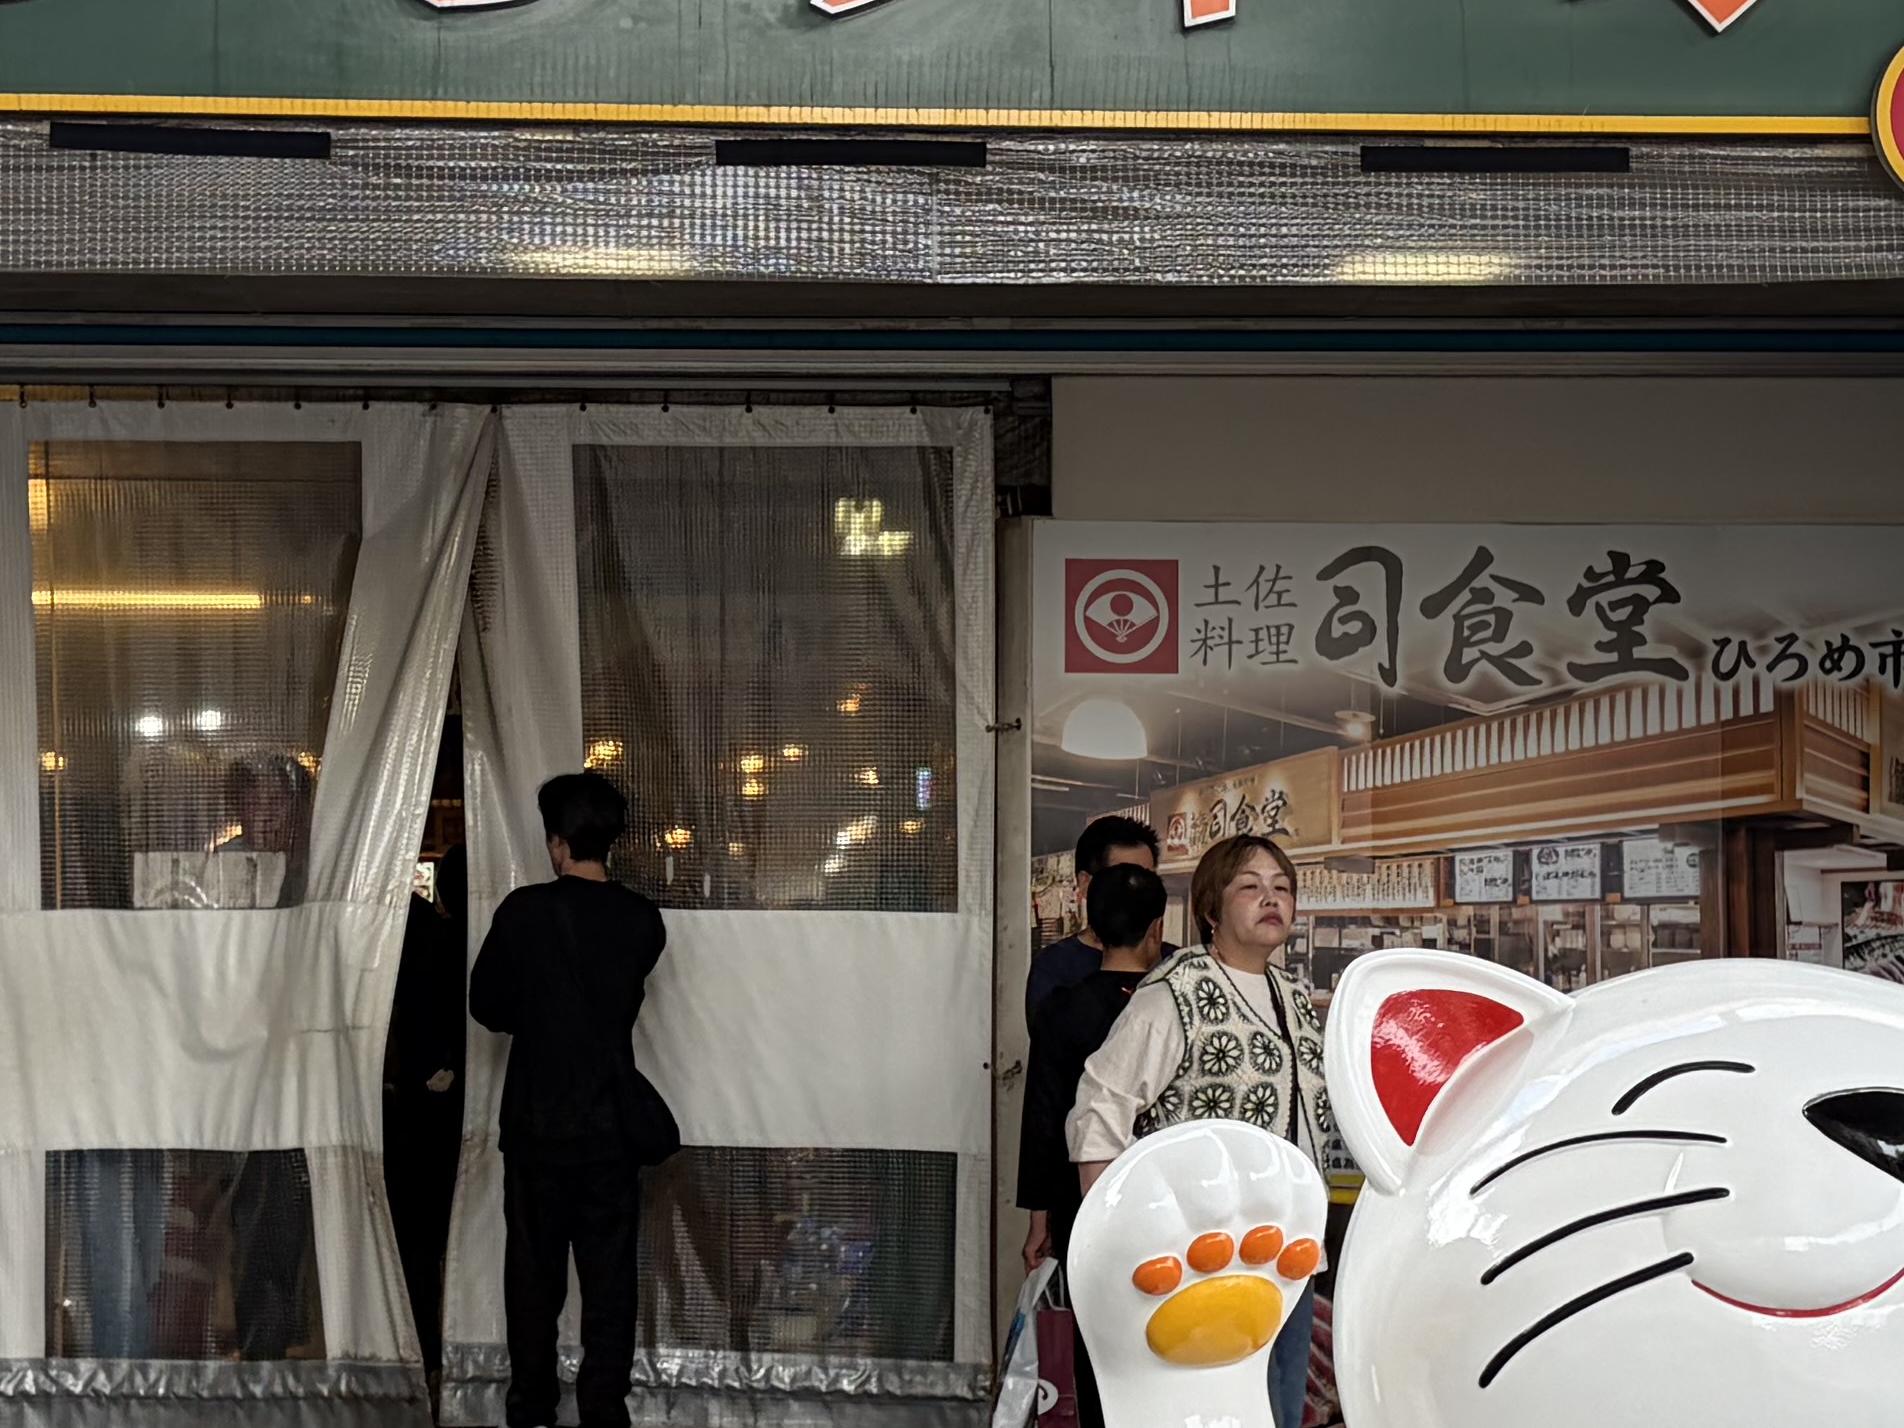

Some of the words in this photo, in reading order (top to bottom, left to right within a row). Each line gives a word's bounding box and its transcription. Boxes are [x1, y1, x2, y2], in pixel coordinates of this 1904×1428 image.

[1193, 563, 1299, 613] 土佐
[1189, 616, 1299, 671] 料理
[1313, 544, 1690, 688] 司食堂
